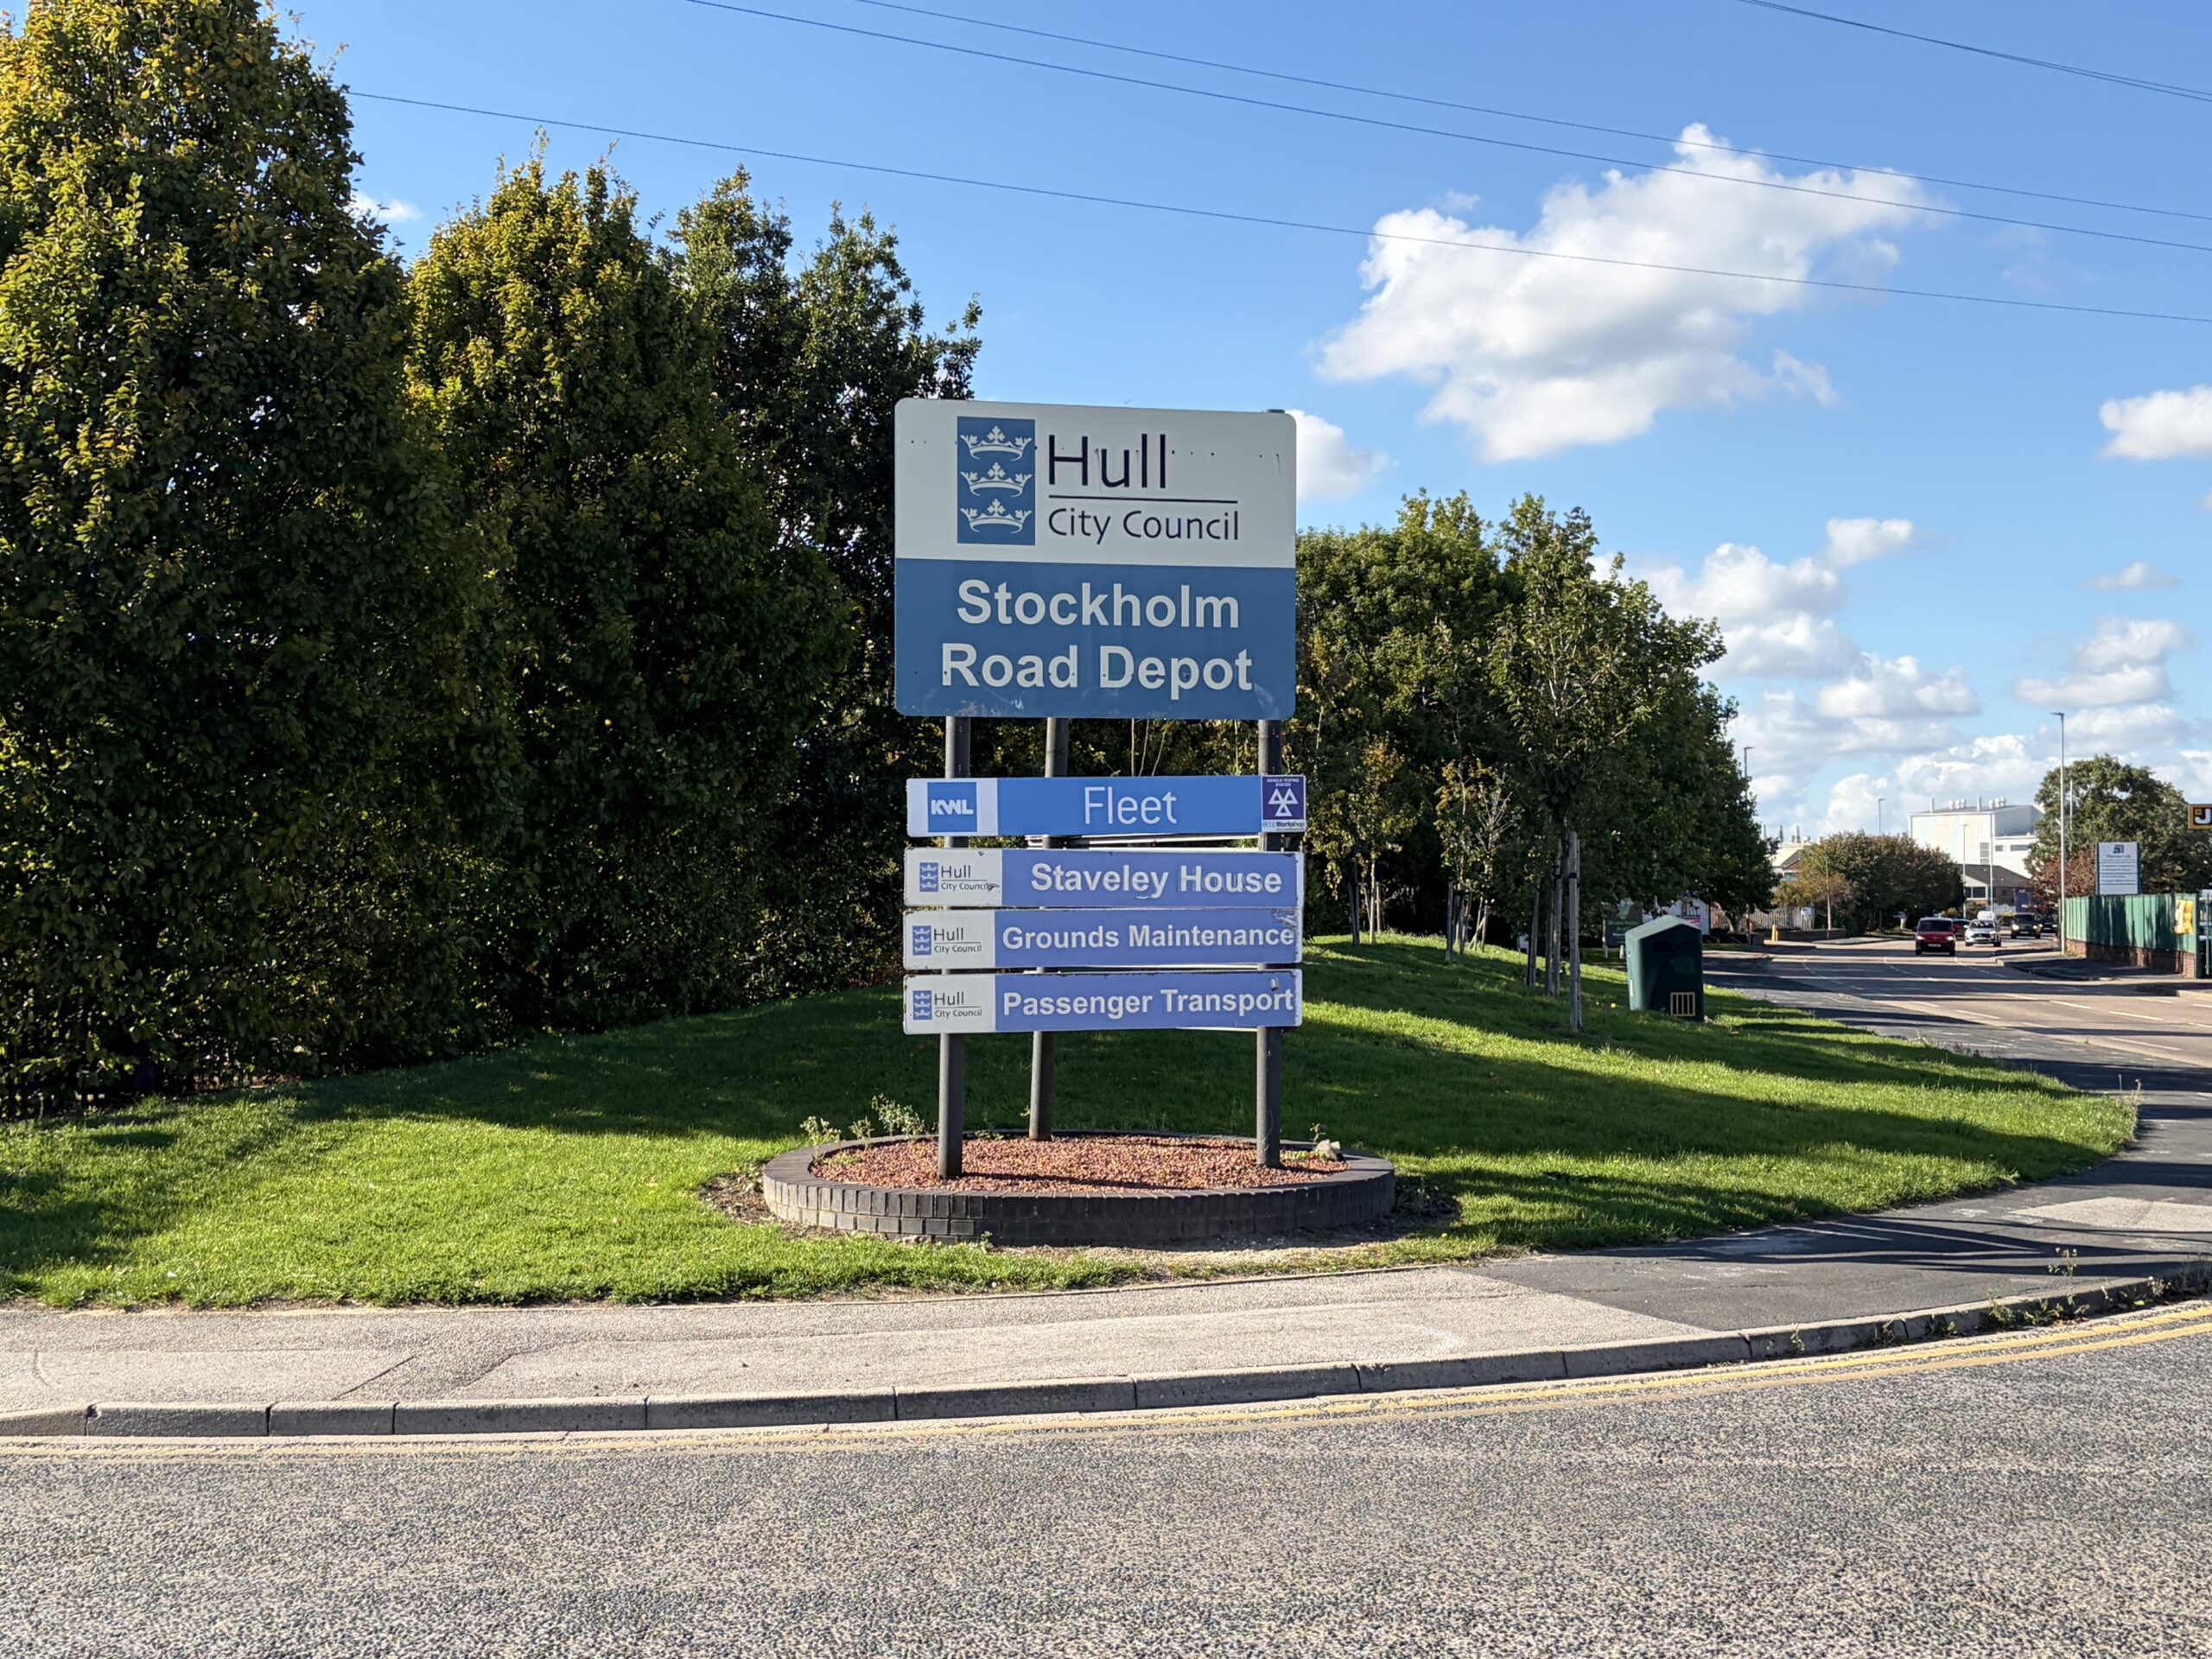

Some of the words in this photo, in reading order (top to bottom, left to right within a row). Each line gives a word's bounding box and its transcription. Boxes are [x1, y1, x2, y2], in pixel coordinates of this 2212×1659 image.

[1049, 434, 1166, 489] Hull
[1048, 508, 1111, 544] City
[1123, 510, 1239, 541] Council
[957, 579, 1240, 629] Stockholm
[941, 643, 1078, 689] Road
[1099, 645, 1253, 701] Depot
[931, 799, 974, 815] KWL
[1084, 786, 1177, 824] Fleet
[940, 864, 971, 879] Hull
[1030, 862, 1169, 899] Staveley
[1179, 865, 1282, 893] House
[940, 882, 957, 892] City
[958, 881, 990, 891] Council
[933, 926, 964, 942] Hull
[1002, 925, 1120, 950] Grounds
[1128, 924, 1295, 948] Maintenance
[933, 944, 950, 955] City
[951, 944, 982, 953] Council
[934, 991, 965, 1007] Hull
[1003, 991, 1153, 1020] Passenger
[1160, 988, 1294, 1020] Transport
[934, 1008, 951, 1019] City
[952, 1008, 982, 1018] Council
